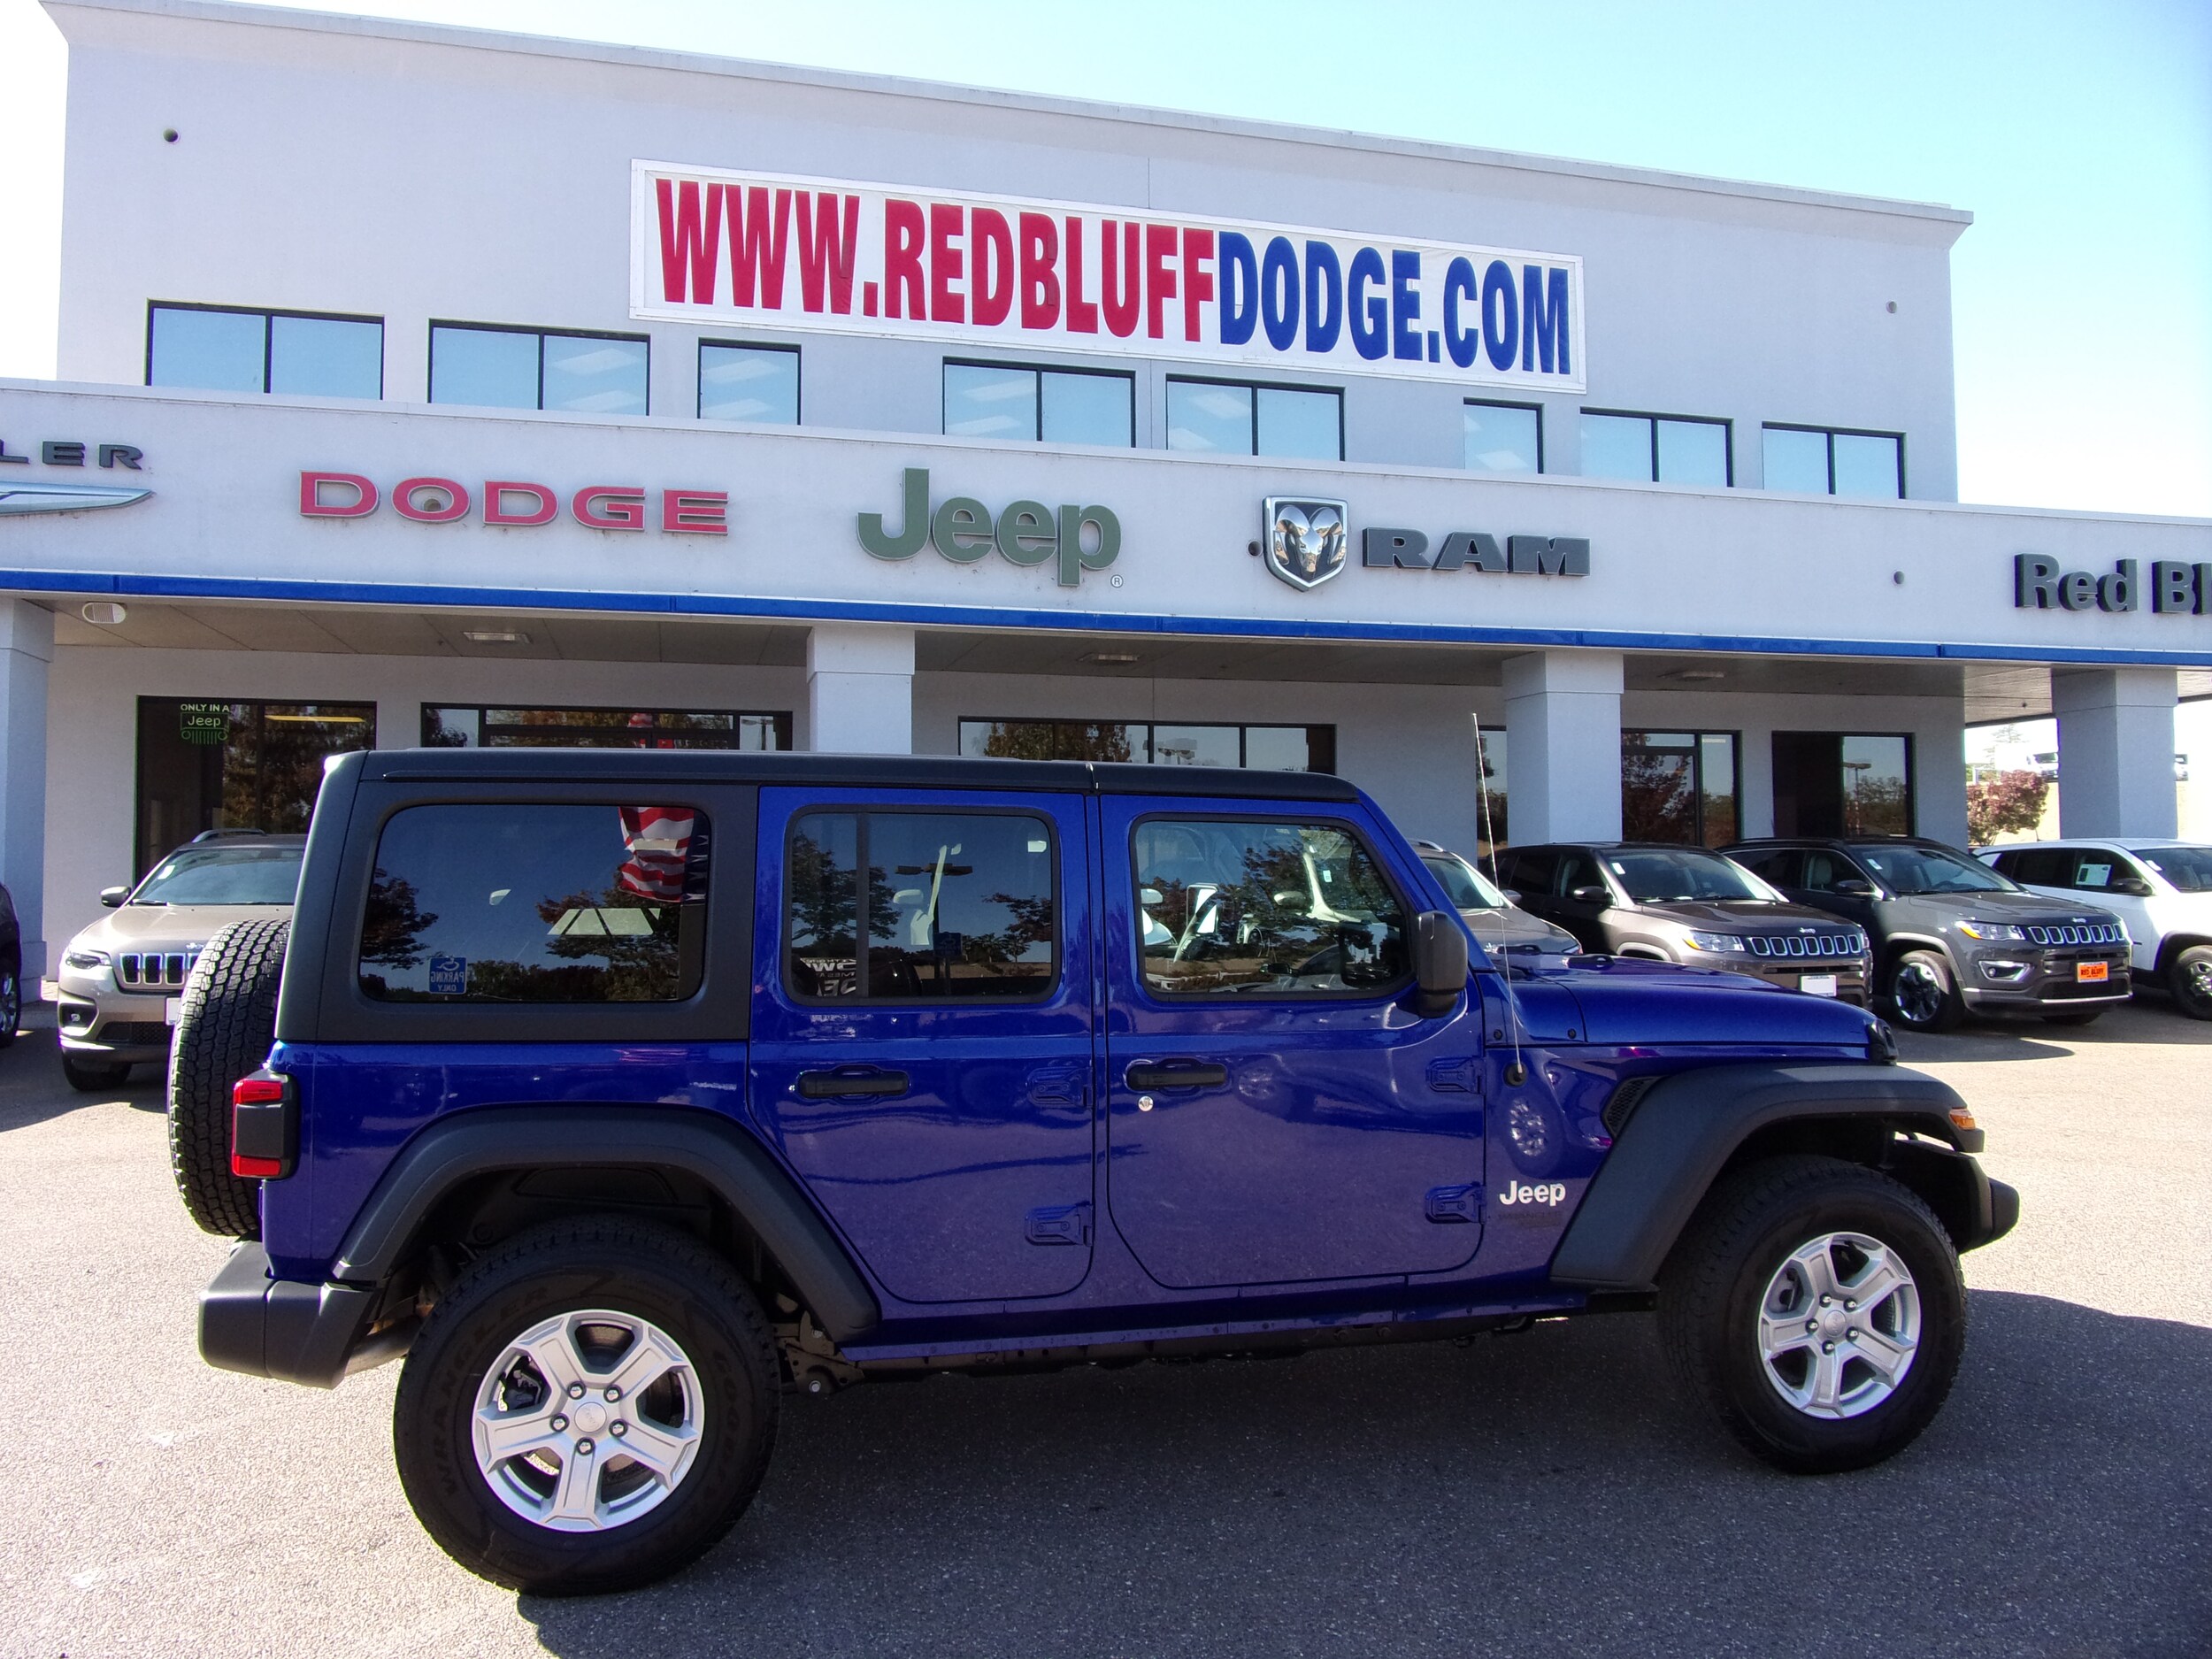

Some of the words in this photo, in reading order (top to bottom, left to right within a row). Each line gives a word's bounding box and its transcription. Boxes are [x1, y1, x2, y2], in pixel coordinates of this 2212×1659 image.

[656, 179, 1571, 374] WWW.REDBLUFFDODGE.COM
[299, 469, 729, 536] DODGE
[856, 467, 1122, 587] Jeep
[1363, 527, 1591, 576] RAM
[2014, 553, 2139, 612] Red
[188, 715, 221, 728] Jeep
[210, 703, 220, 712] IN
[1499, 1180, 1566, 1207] Jeep
